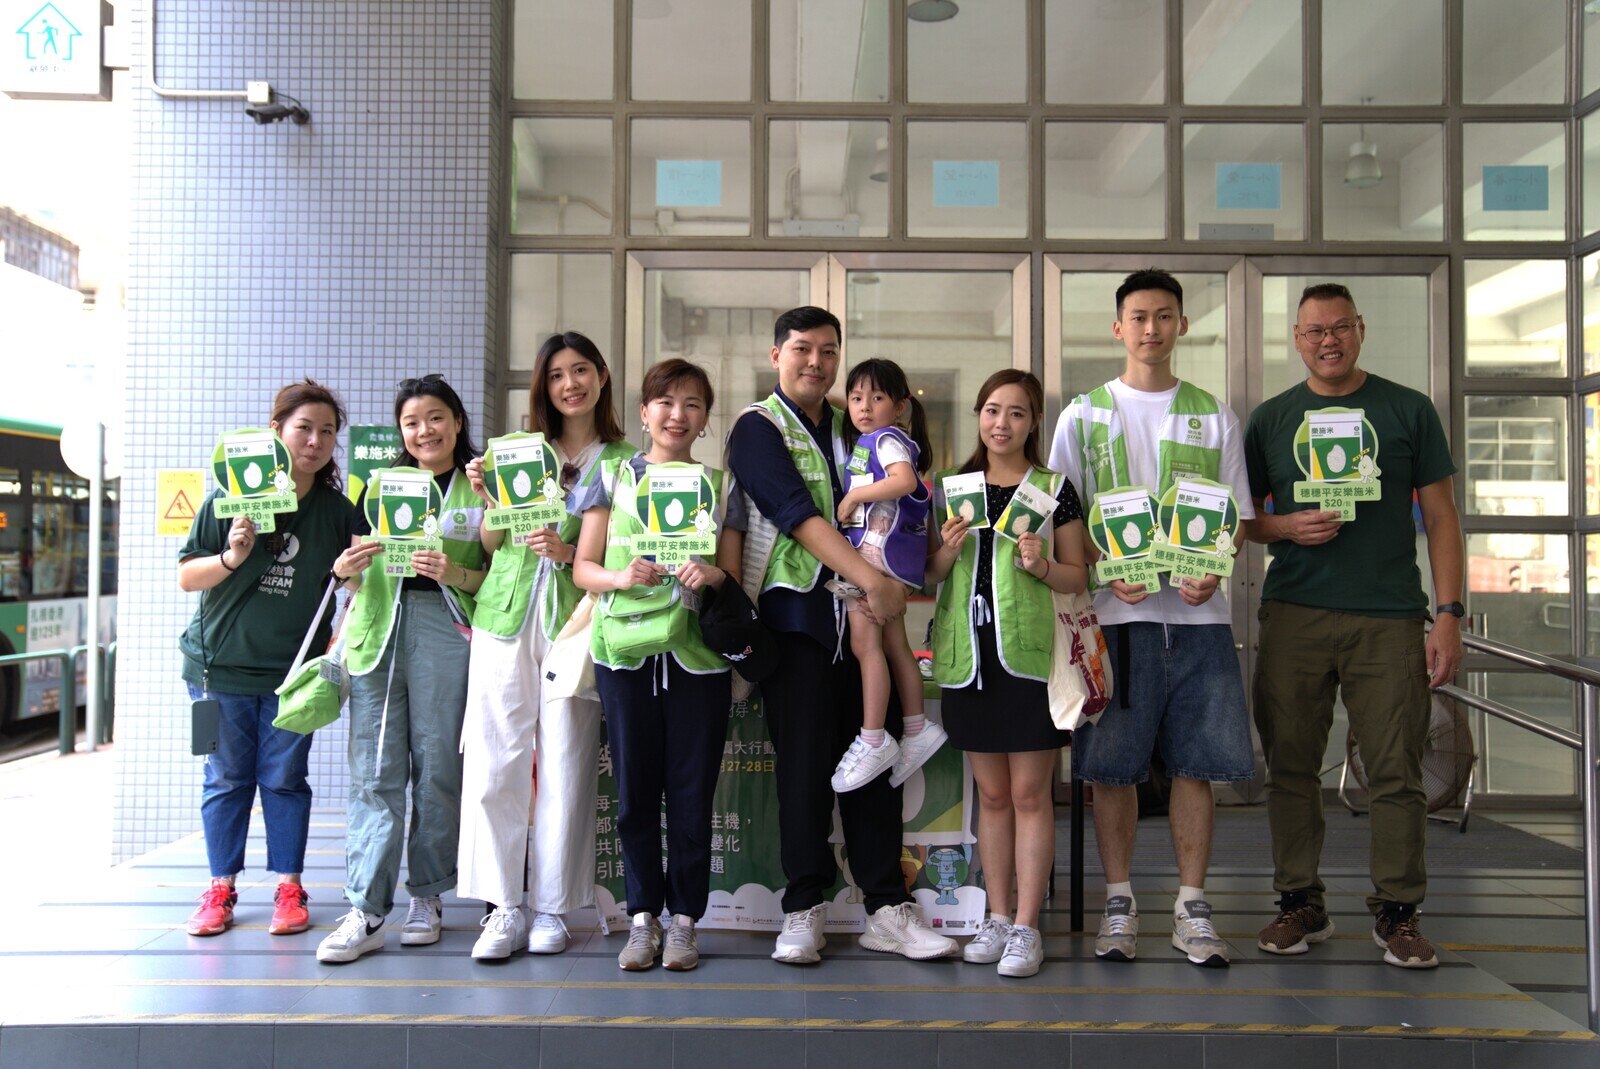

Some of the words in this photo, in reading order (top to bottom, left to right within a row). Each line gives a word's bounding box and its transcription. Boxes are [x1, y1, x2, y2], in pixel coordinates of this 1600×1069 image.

[354, 445, 397, 460] 樂施米
[496, 453, 517, 461] 樂施米
[382, 484, 404, 492] 樂施米
[1300, 487, 1375, 498] 穗穗平安樂施米
[220, 499, 292, 514] 穗穗平安樂施米
[491, 509, 561, 526] 穗穗平安樂施米
[637, 541, 710, 551] 穗穗平安樂施米
[1155, 549, 1228, 572] 穗穗平安樂施米
